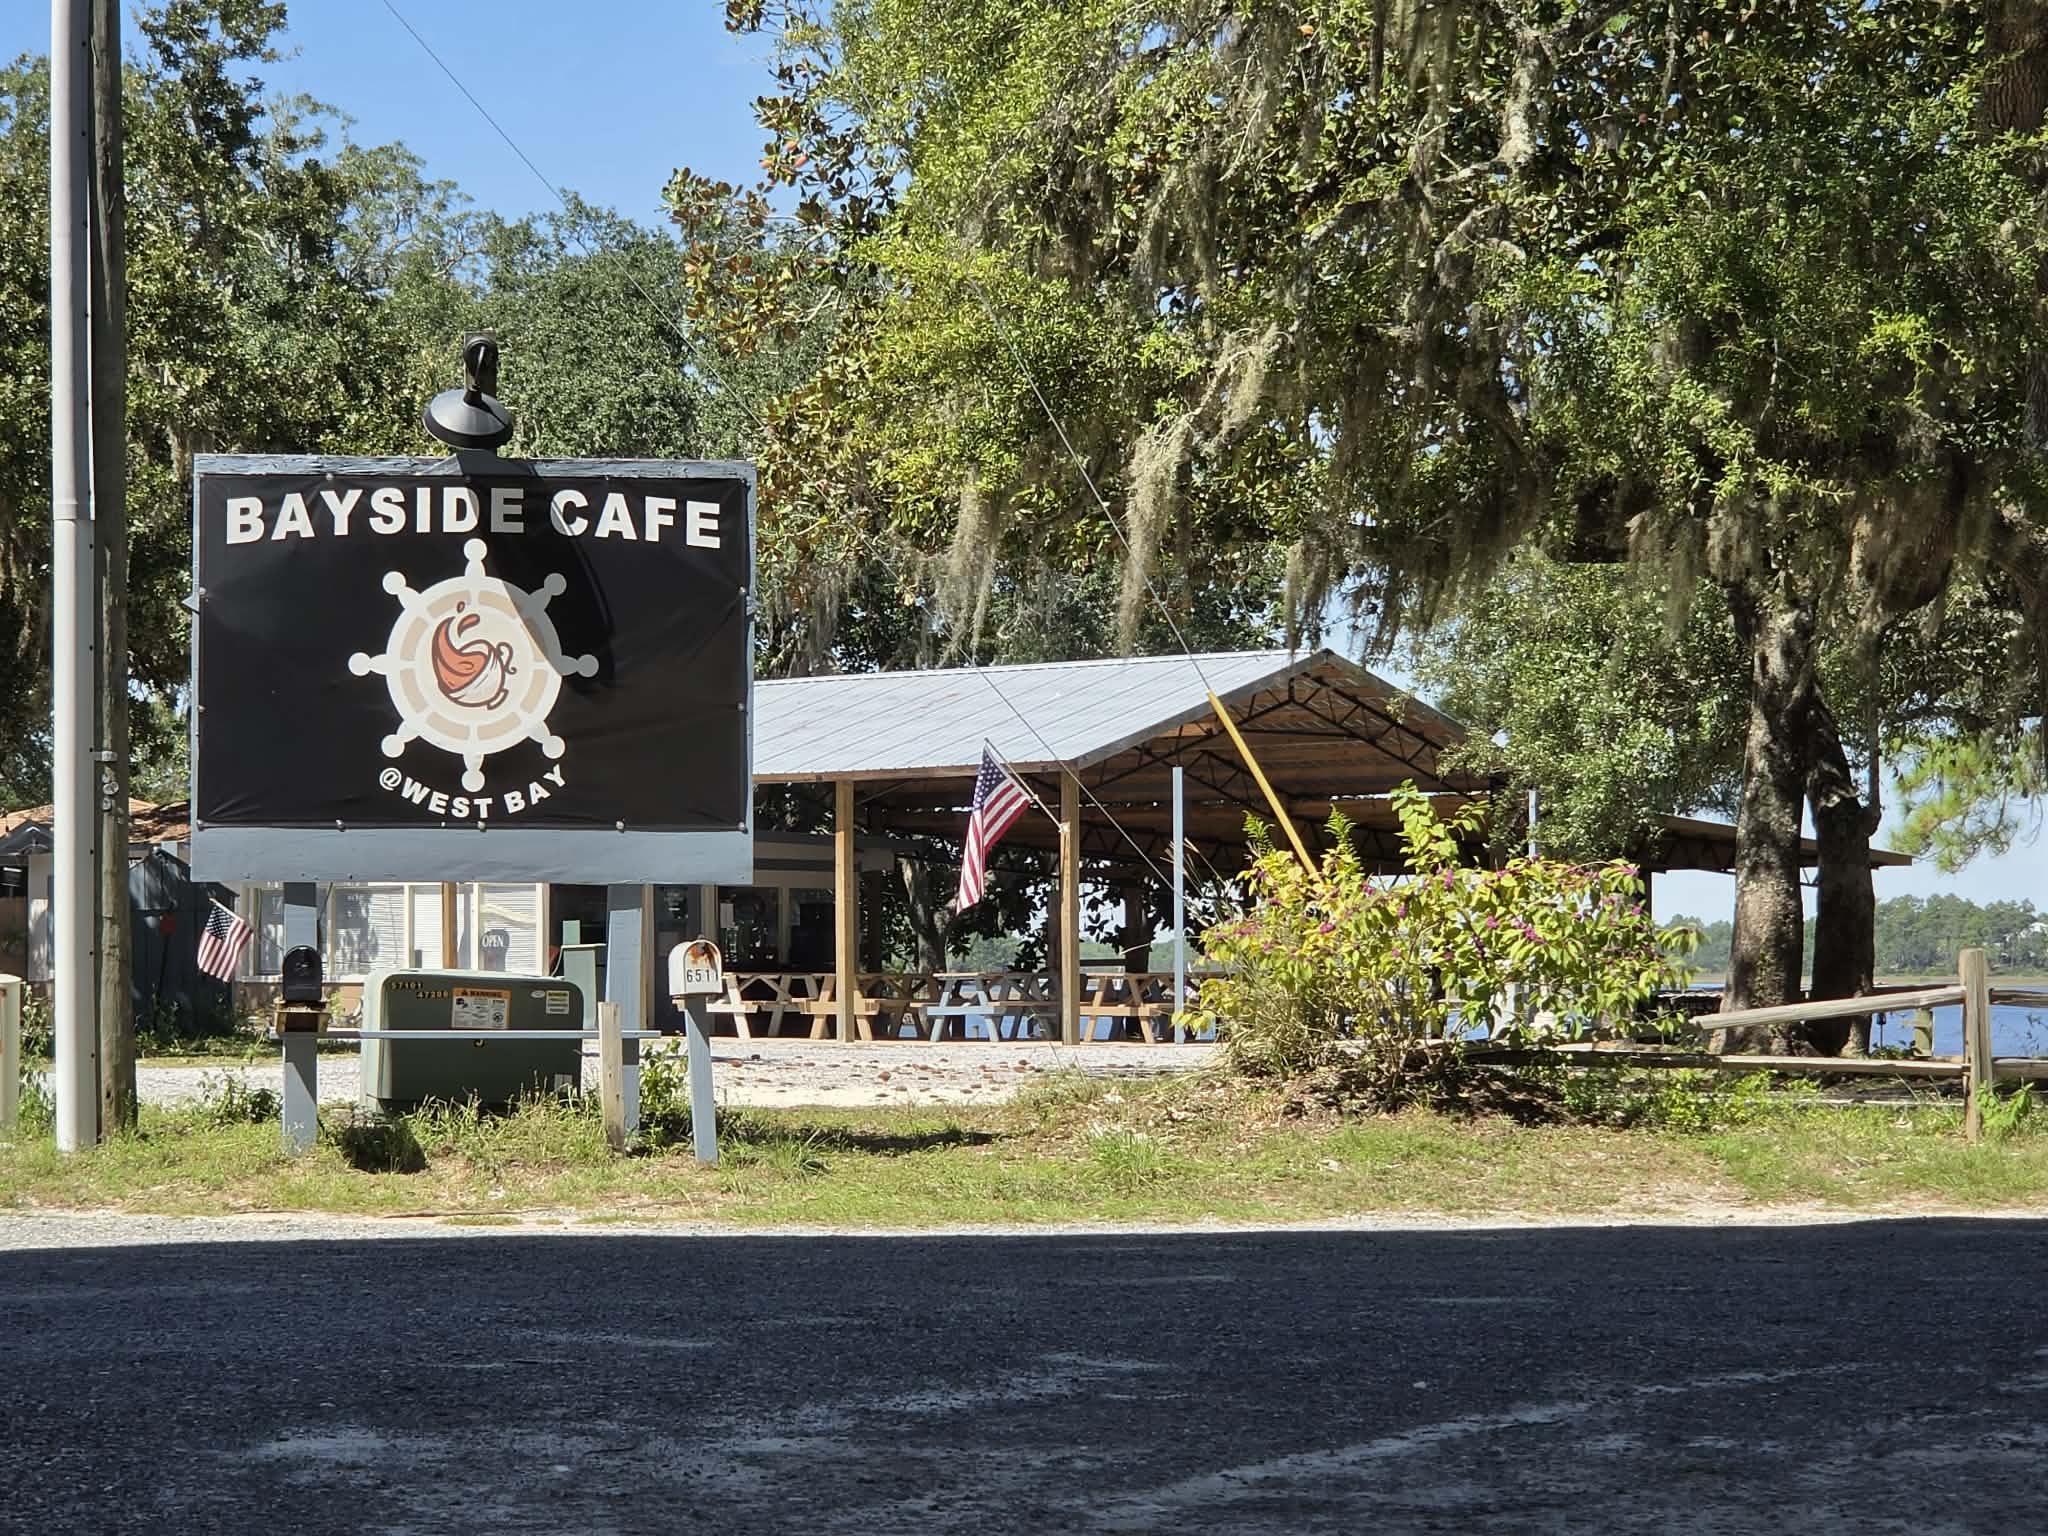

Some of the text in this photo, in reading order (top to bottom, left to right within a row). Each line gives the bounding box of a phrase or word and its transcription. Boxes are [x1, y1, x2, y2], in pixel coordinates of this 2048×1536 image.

[226, 487, 721, 549] BAYSIDE CAFE
[379, 764, 566, 819] @WEST BAY
[481, 934, 504, 948] OPEN
